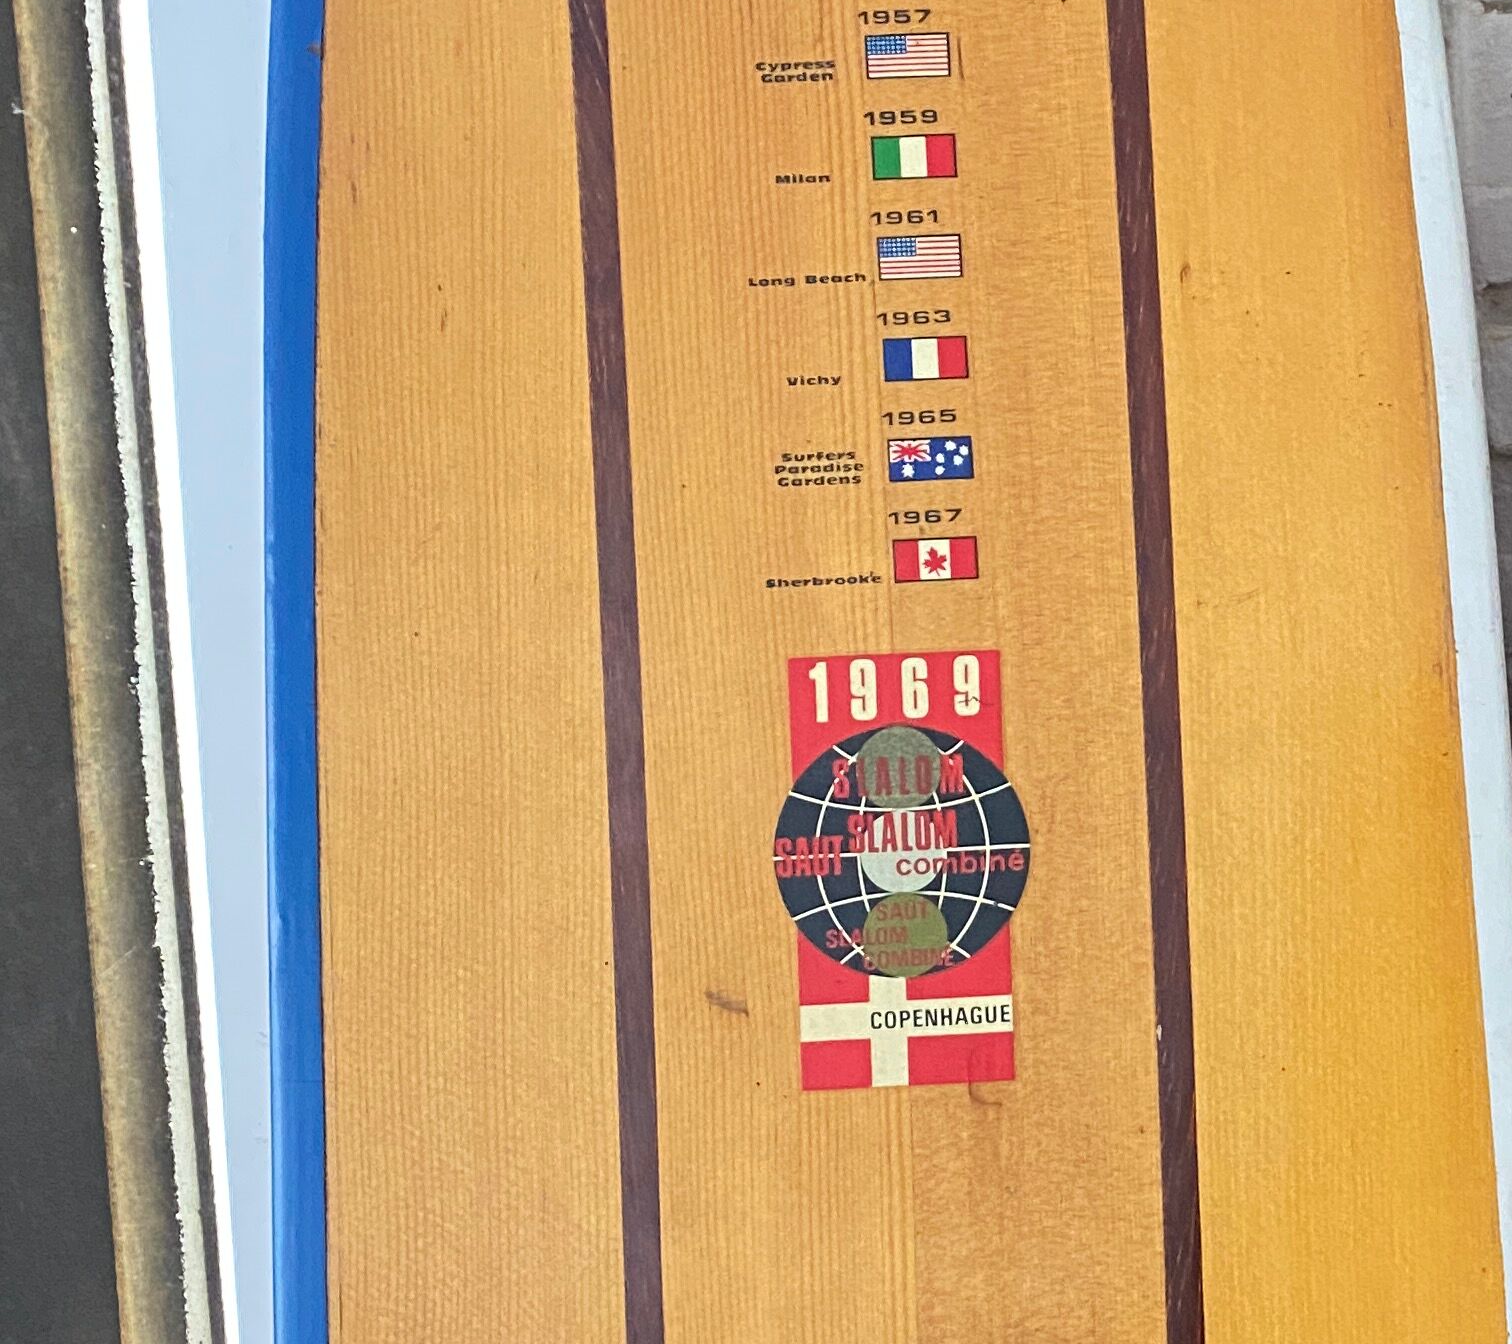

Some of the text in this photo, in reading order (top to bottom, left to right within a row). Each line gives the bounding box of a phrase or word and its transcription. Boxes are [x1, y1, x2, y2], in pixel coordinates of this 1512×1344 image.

[858, 9, 931, 25] 1957
[755, 60, 836, 72] Cypress
[761, 71, 833, 83] Garden
[864, 110, 938, 126] 1959
[775, 173, 831, 184] Milan
[870, 210, 939, 225] 1961
[748, 272, 866, 287] Long Beach
[877, 310, 952, 326] 1963
[787, 375, 841, 387] Vichy
[881, 409, 957, 426] 1965
[781, 450, 856, 462] Surfers
[774, 462, 864, 474] Paradise
[777, 474, 862, 487] Gardens
[889, 508, 962, 525] 1967
[766, 574, 882, 588] Sherbrooke
[808, 654, 980, 723] 1969
[832, 753, 965, 799] SLALOM
[847, 809, 958, 854] SLALOM
[775, 835, 844, 879] SAUT
[870, 1002, 1011, 1030] COPENHAGUE
